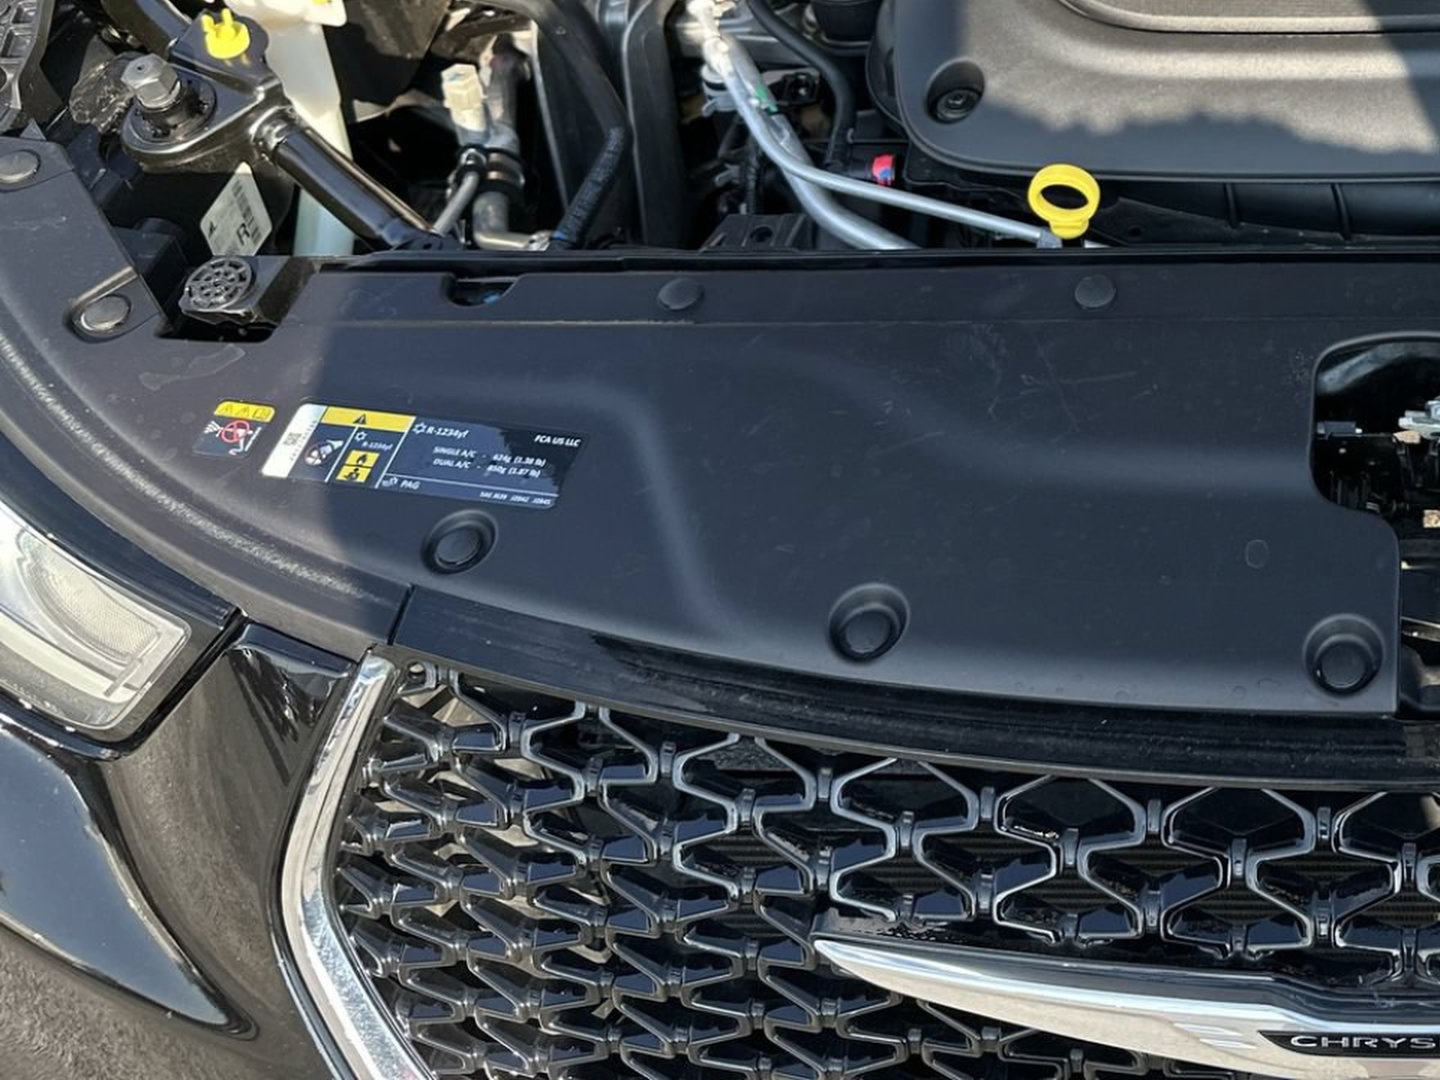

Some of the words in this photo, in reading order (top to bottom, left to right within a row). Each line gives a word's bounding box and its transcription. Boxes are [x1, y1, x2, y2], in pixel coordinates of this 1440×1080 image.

[426, 425, 469, 439] R-1234yf
[534, 434, 551, 444] FCA
[552, 436, 565, 446] US
[565, 438, 581, 448] LLC
[460, 449, 477, 458] A/C
[432, 458, 454, 467] DUAL
[454, 460, 471, 469] A/C
[400, 479, 420, 491] PAG
